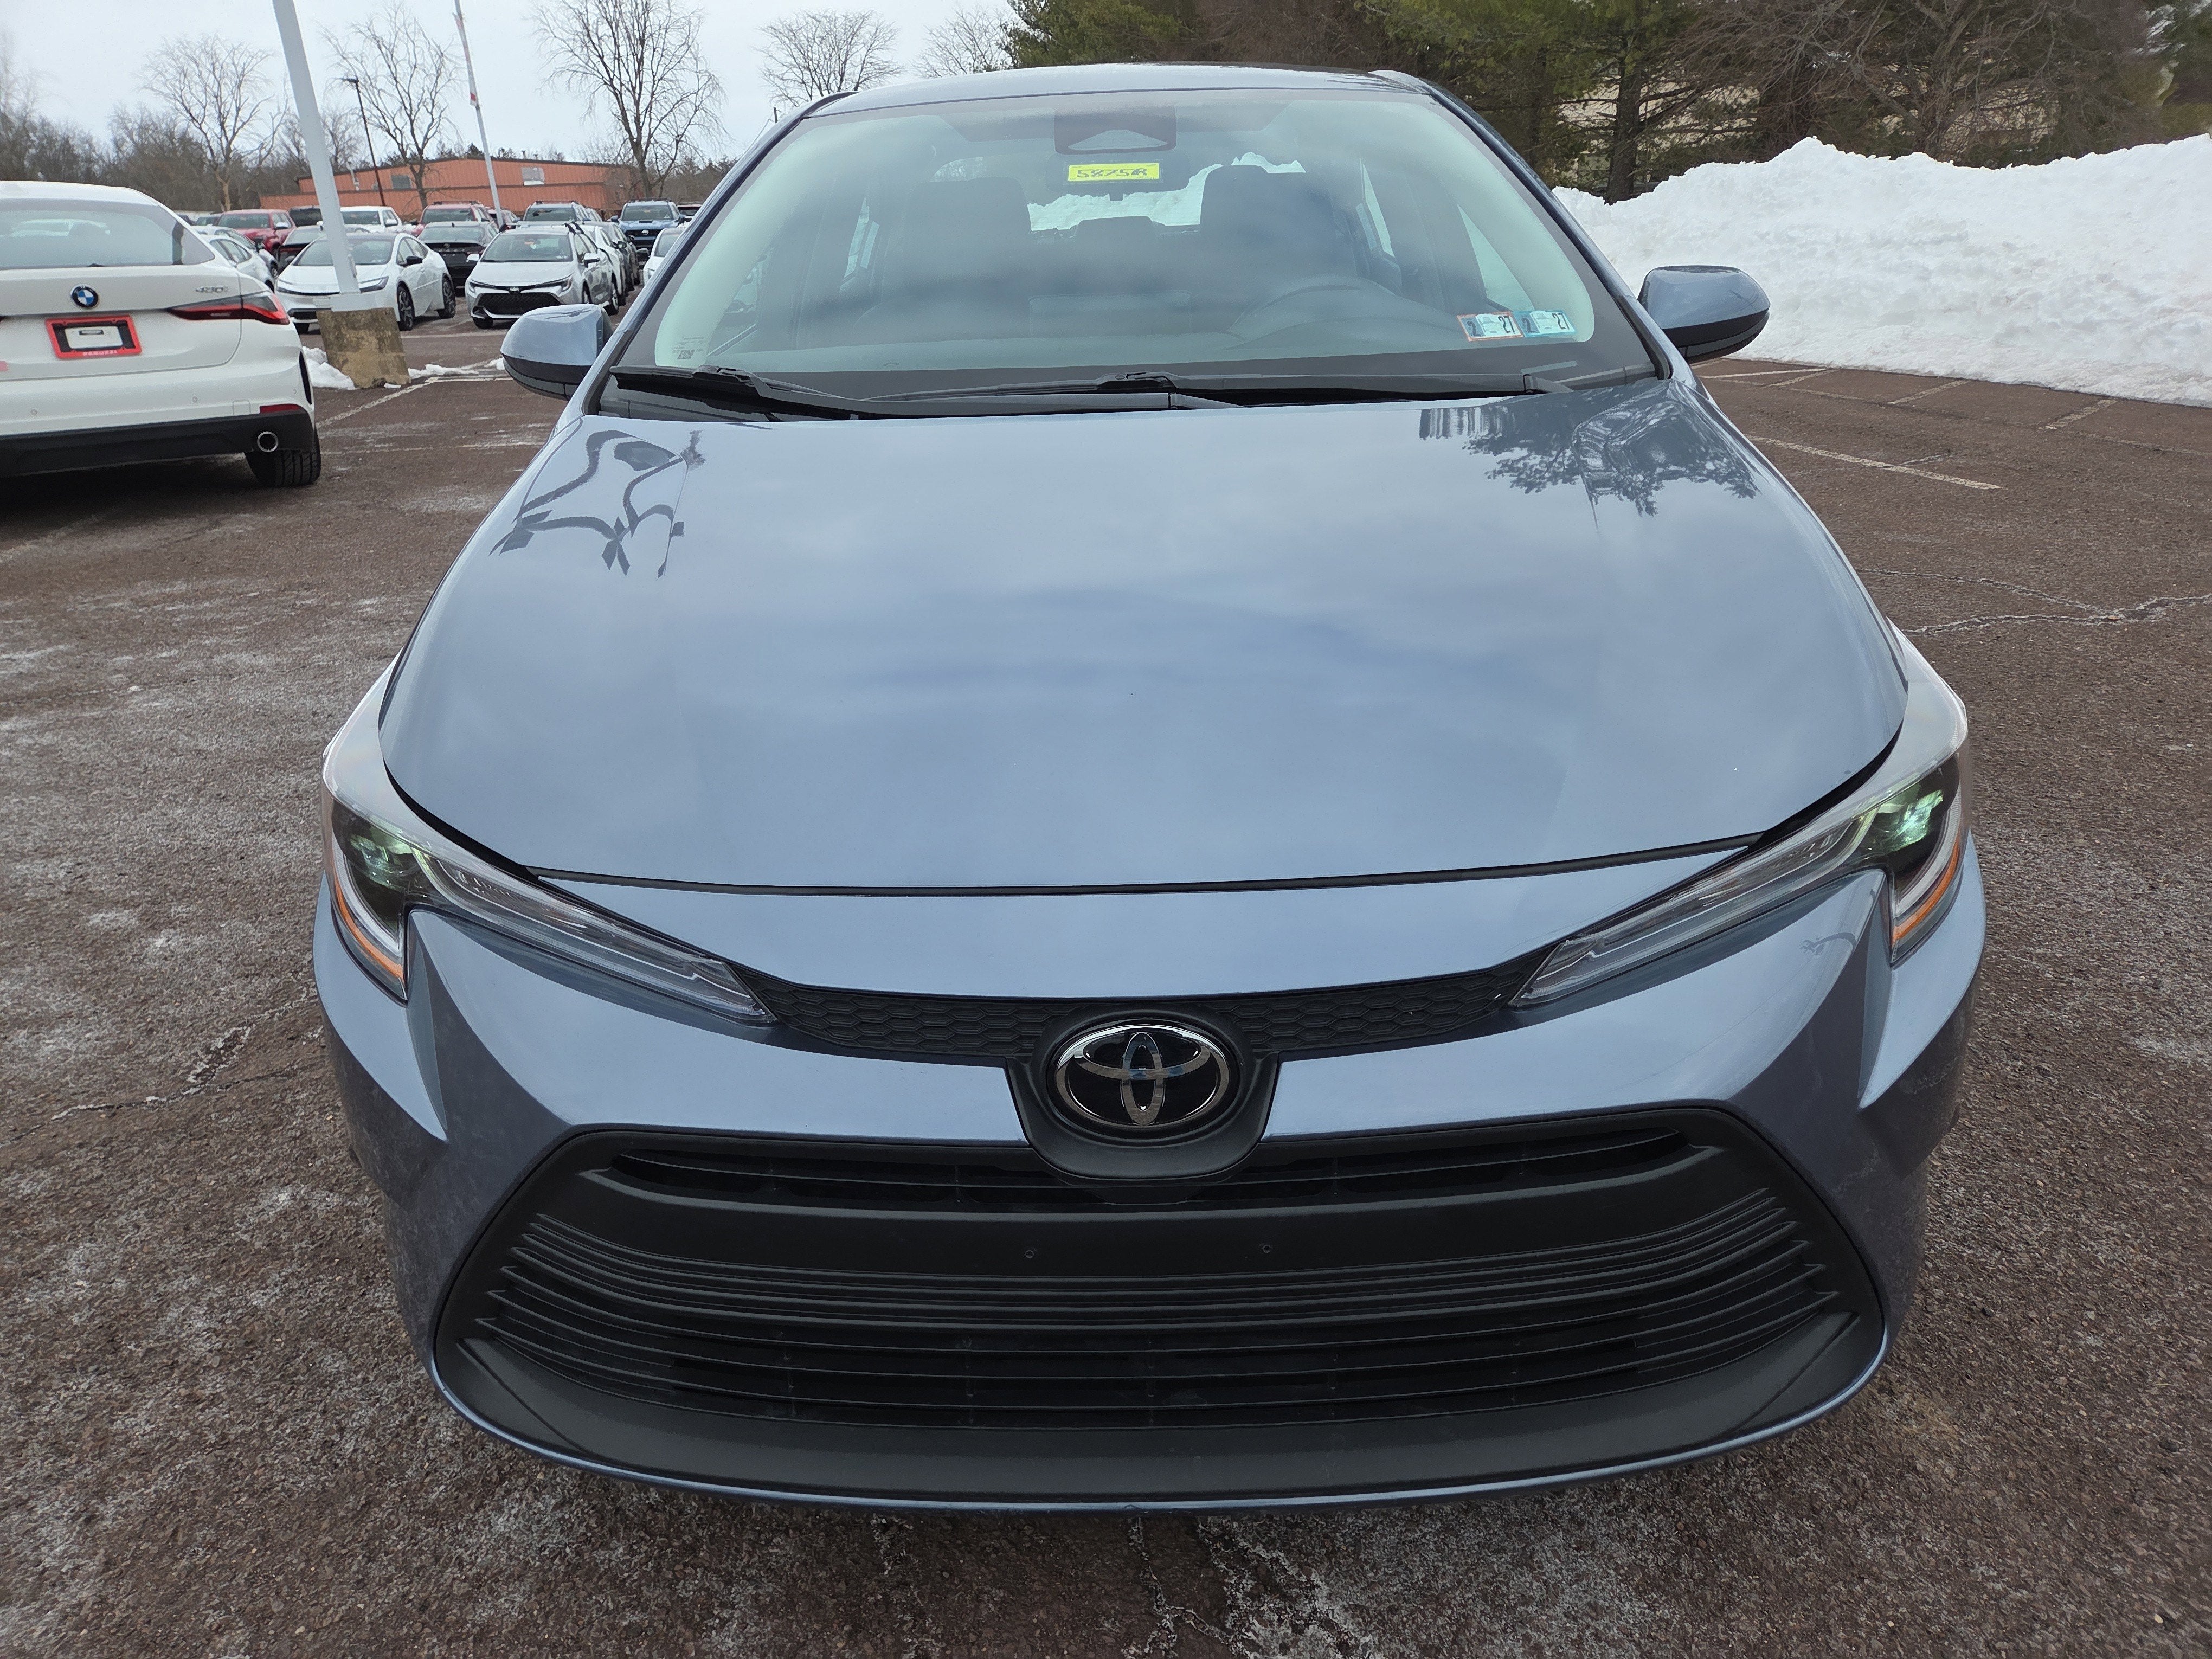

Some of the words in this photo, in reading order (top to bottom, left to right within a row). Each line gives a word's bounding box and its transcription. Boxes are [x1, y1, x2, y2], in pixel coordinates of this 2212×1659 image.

[1467, 321, 1482, 336] 2
[1497, 315, 1515, 334] 27
[1521, 318, 1536, 333] 2
[1552, 313, 1570, 330] 27
